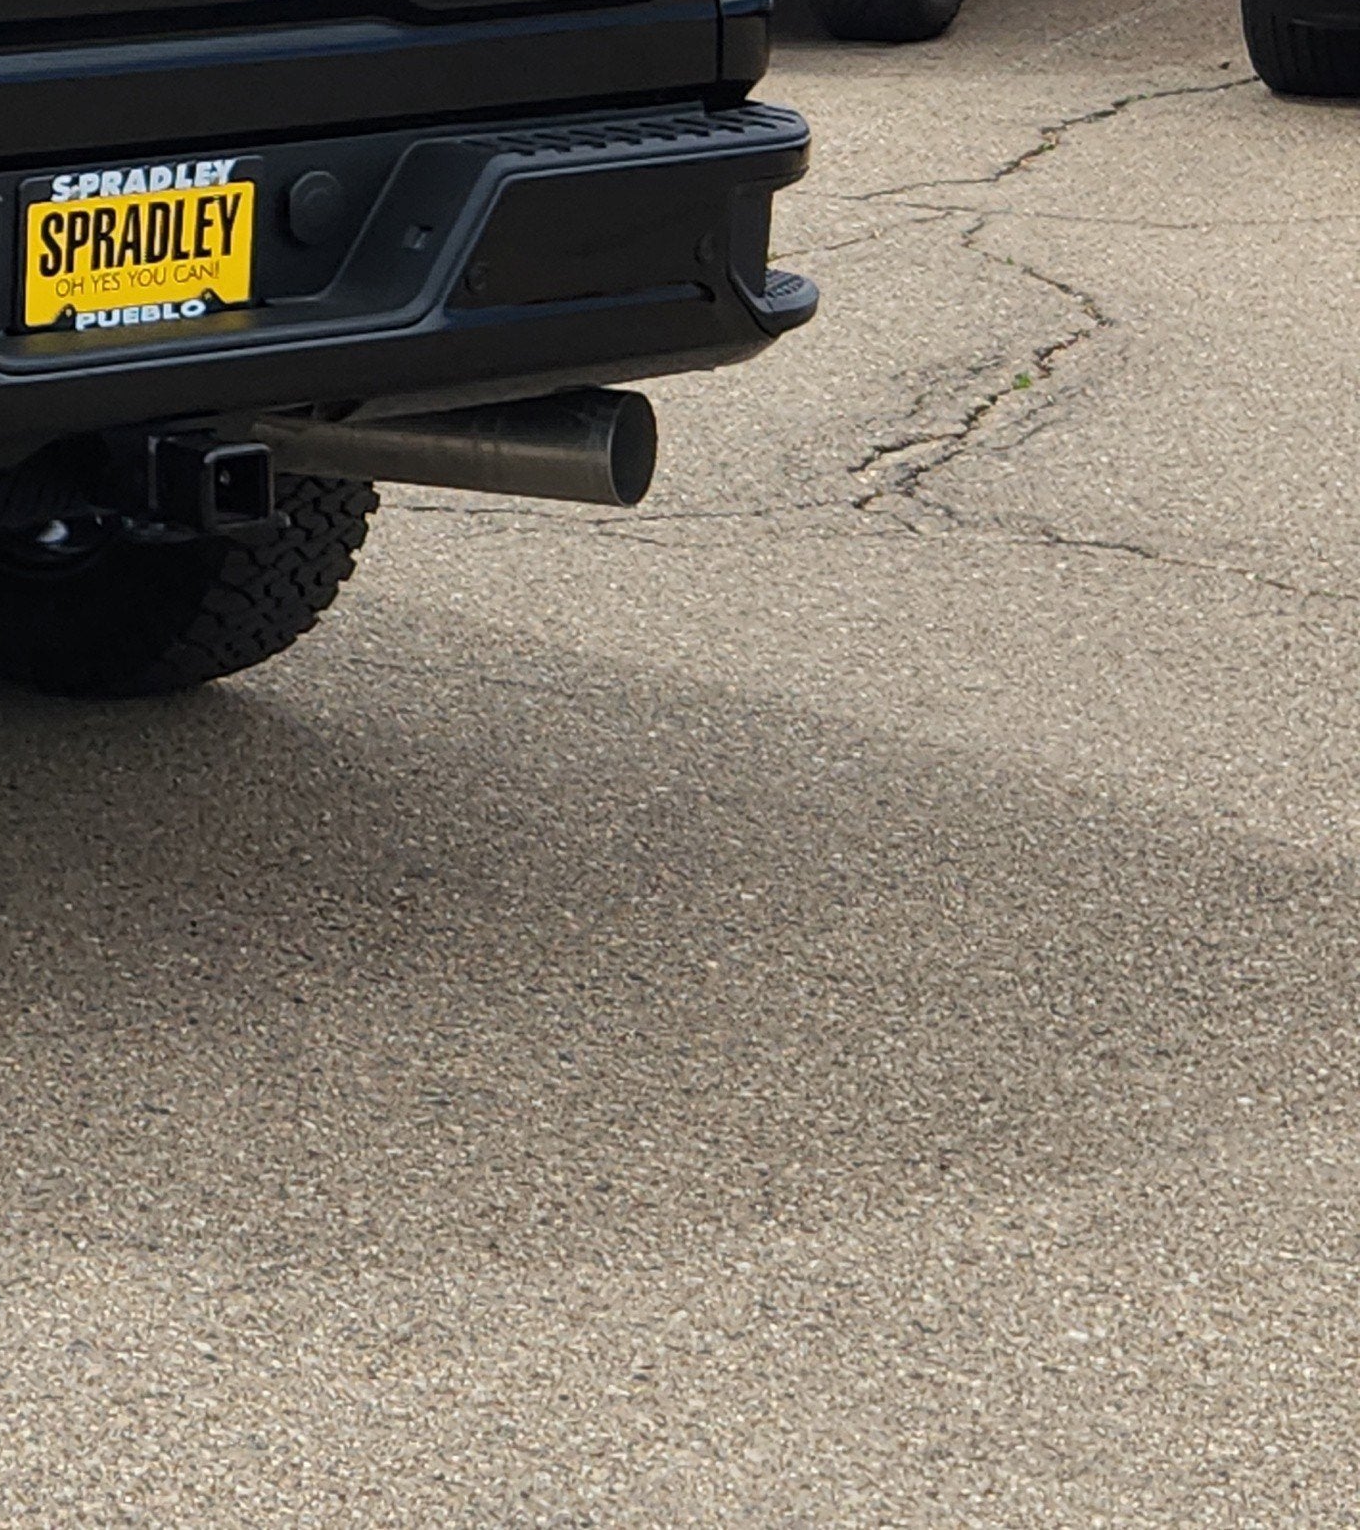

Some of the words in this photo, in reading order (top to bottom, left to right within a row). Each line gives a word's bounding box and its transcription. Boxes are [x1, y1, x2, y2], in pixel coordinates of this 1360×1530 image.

[50, 158, 239, 203] SPRADLEY
[38, 191, 243, 278] SPRADLEY
[55, 277, 85, 298] OH
[91, 271, 121, 294] YES
[126, 266, 167, 288] YOU
[173, 260, 220, 284] CAN!
[75, 298, 207, 332] PUEBLO
